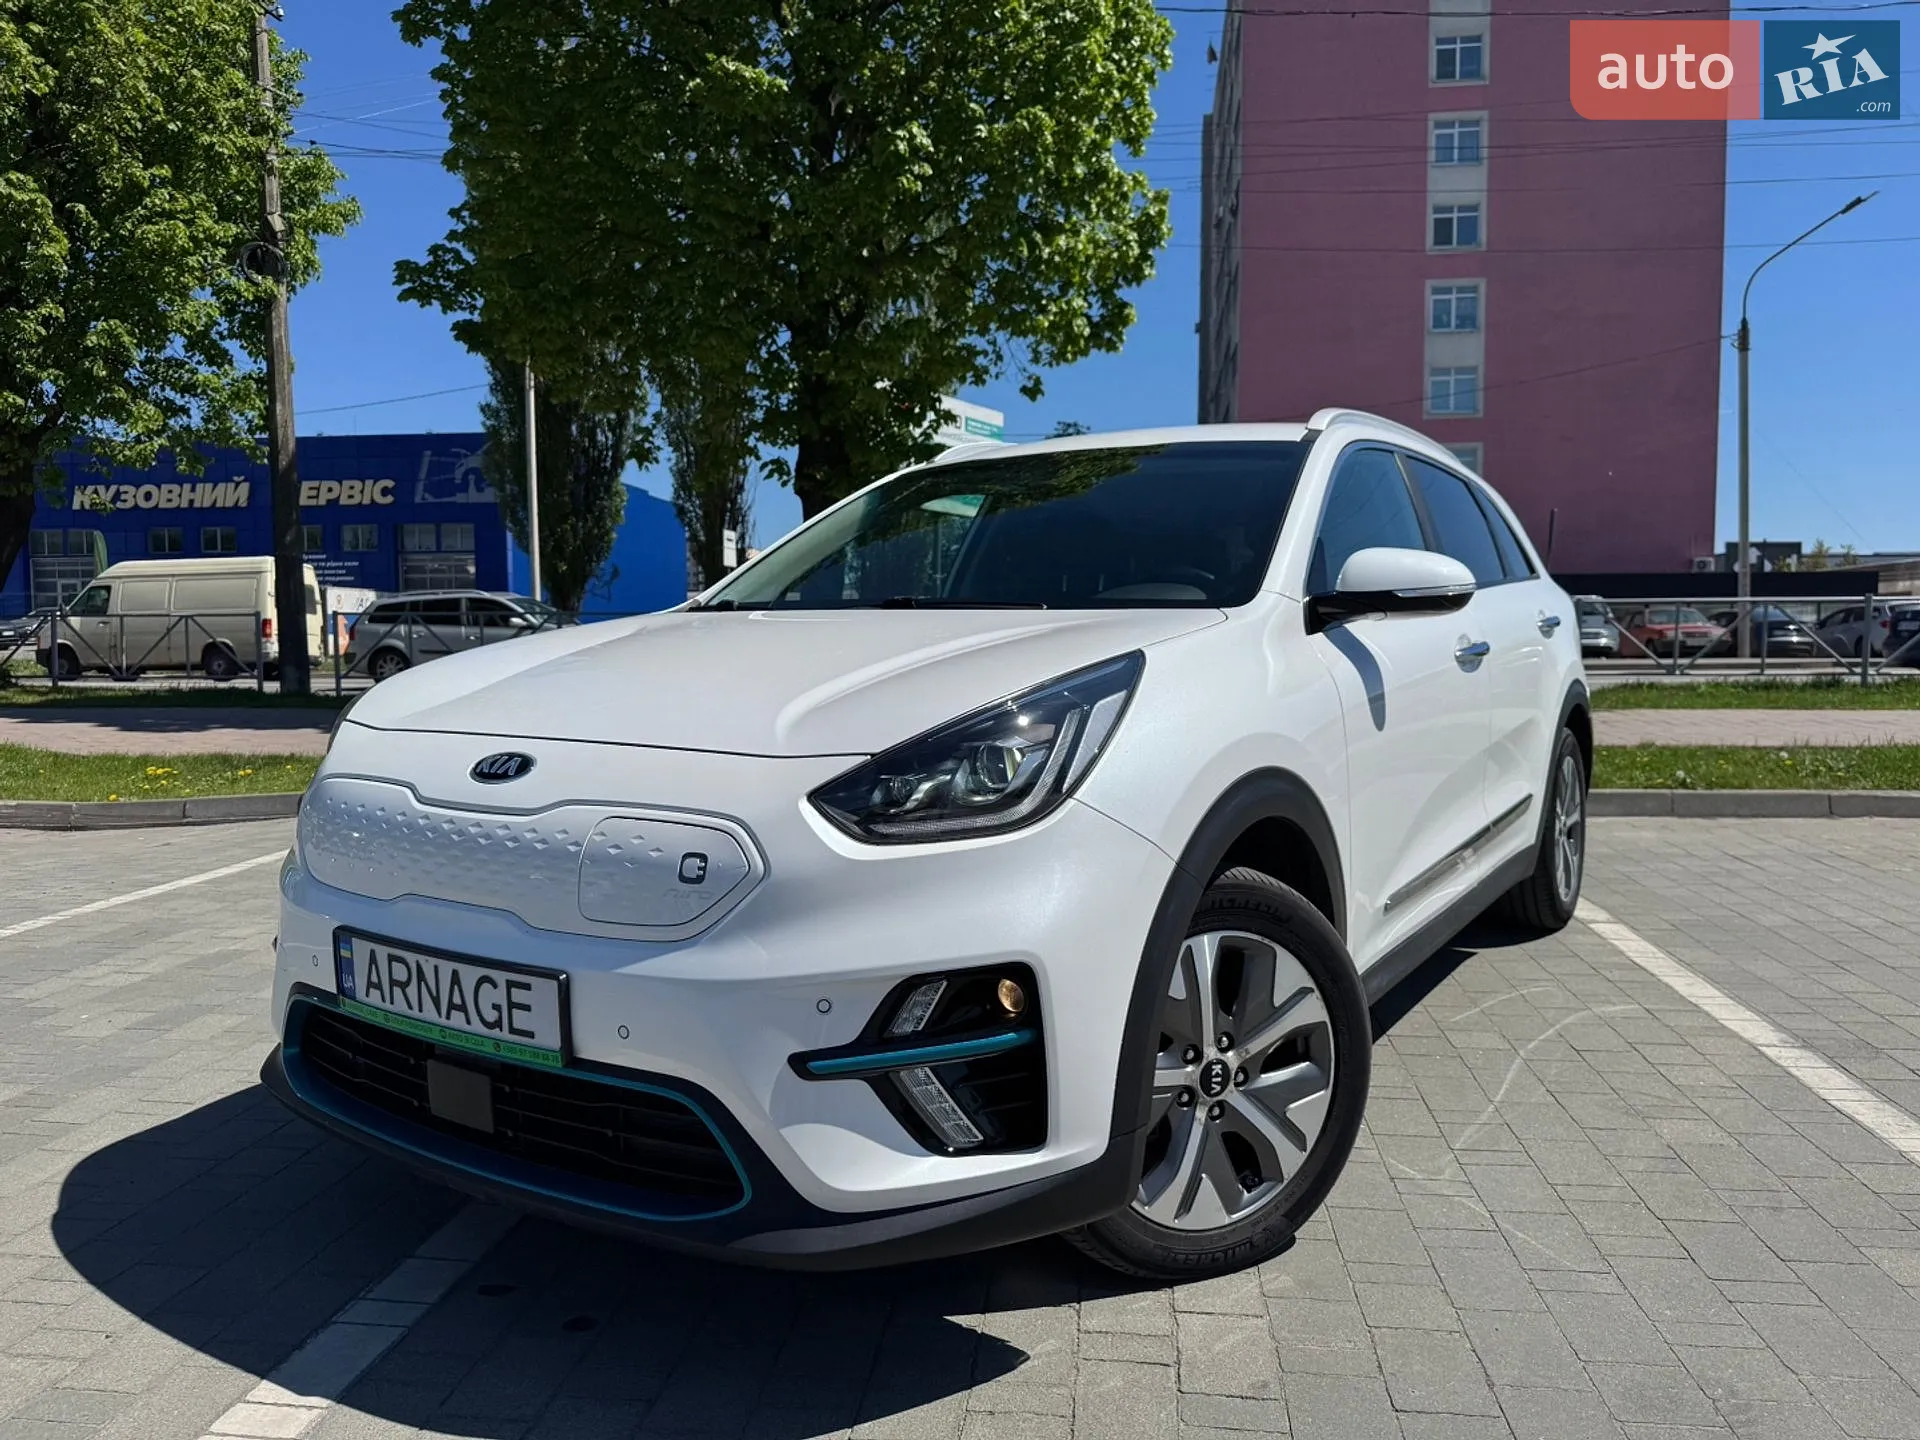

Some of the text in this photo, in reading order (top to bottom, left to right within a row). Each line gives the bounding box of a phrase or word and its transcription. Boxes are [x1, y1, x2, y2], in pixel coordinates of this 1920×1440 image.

[72, 475, 396, 511] КУЗОВНИЙ ЕРВІС
[475, 756, 522, 776] KIA
[365, 948, 535, 1040] ARNAGE
[1210, 1064, 1222, 1094] KIA
